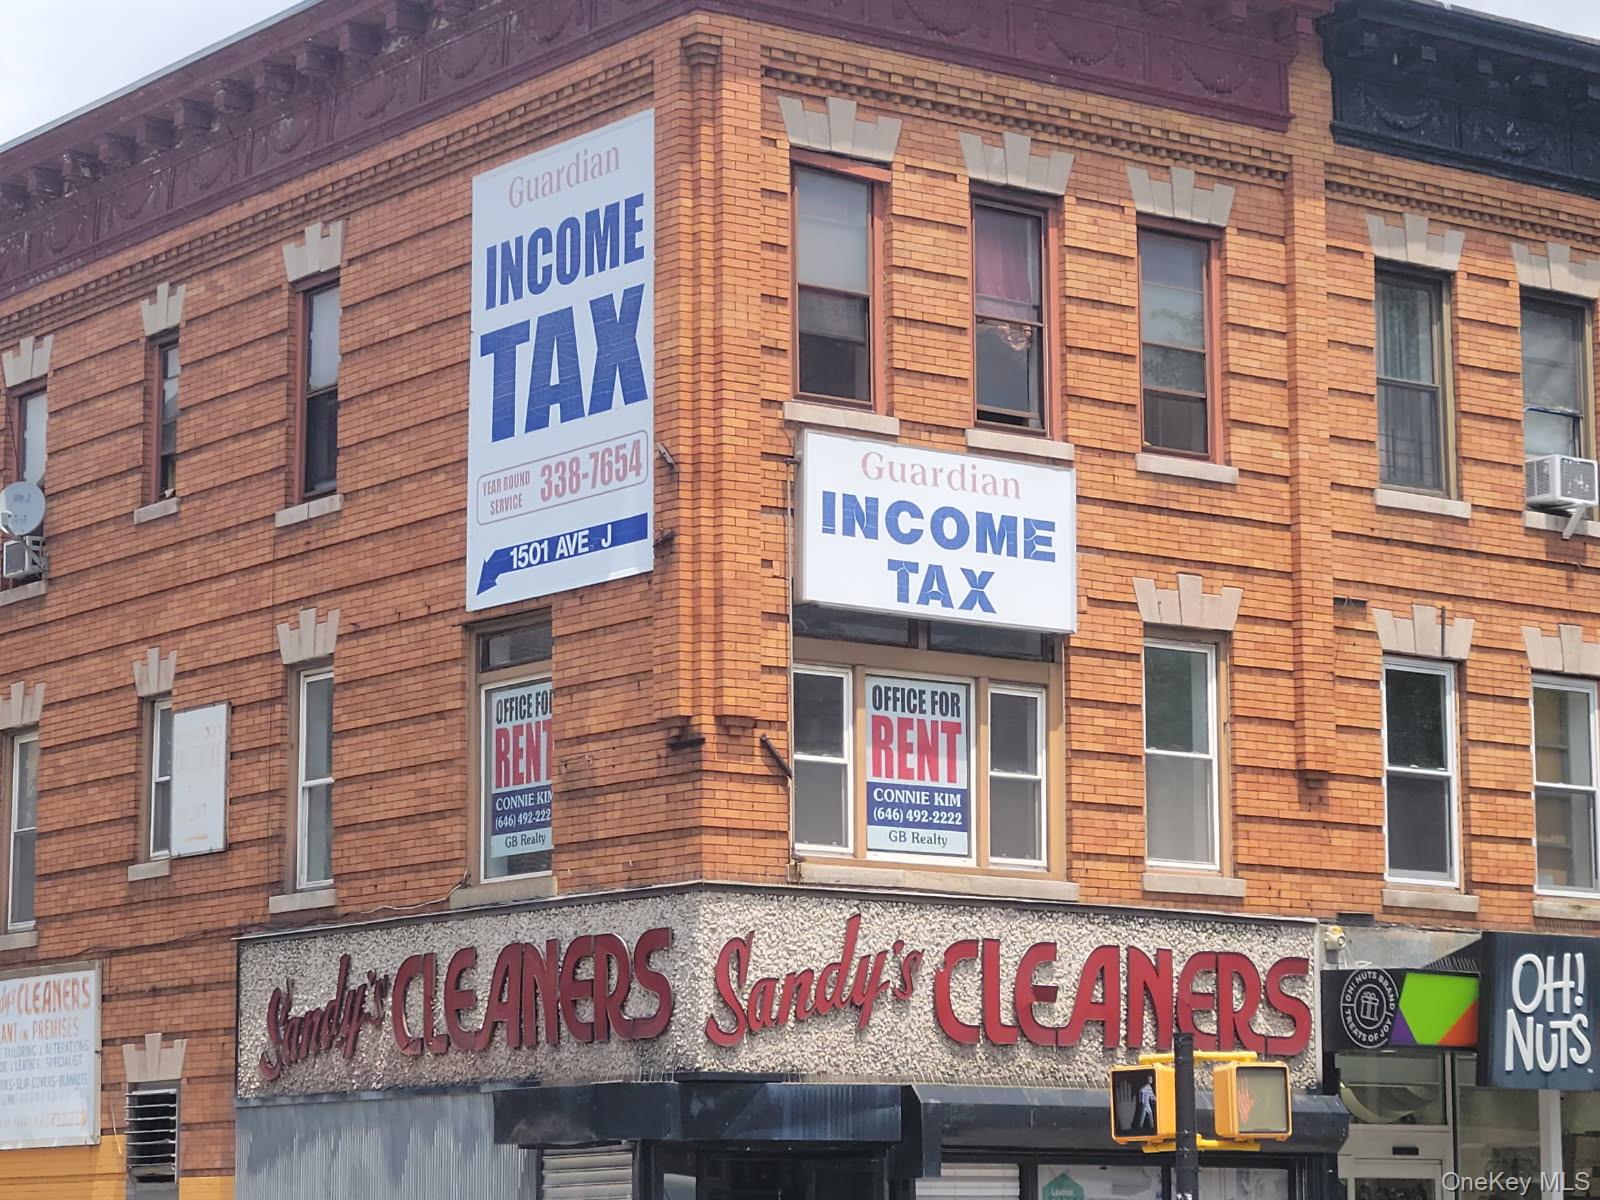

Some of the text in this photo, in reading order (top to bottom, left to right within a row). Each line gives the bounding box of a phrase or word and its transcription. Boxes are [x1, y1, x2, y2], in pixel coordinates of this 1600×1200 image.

[508, 146, 621, 208] Guardian
[485, 192, 645, 311] INCOME
[480, 283, 649, 443] TAX
[482, 470, 531, 497] YEAR ROUND
[540, 439, 642, 503] 338-7654
[860, 451, 1021, 499] Guardian
[490, 493, 523, 516] SERVICE
[510, 540, 549, 569] 1501
[601, 523, 612, 548] J
[821, 490, 1056, 563] INCOME
[887, 558, 997, 614] TAX
[496, 692, 533, 725] OFFICE
[871, 684, 961, 718] OFFICE FOR
[495, 719, 552, 789] RENT
[871, 714, 962, 784] RENT
[496, 792, 534, 812] CONNIE
[873, 788, 962, 808] CONNIE KIM
[873, 807, 963, 826] (646) 492-2222
[495, 808, 552, 831] (646) 492-222
[504, 832, 546, 848] GB Realty
[888, 830, 948, 848] GB Realty
[16, 975, 91, 1016] CLEANERS
[258, 926, 675, 1081] Sandy's CLEANERS
[703, 913, 1313, 1057] Sandy's CLEANERS
[1345, 970, 1396, 1010] OH! NUTS BRAND
[1511, 952, 1586, 1014] OH!
[32, 1015, 80, 1041] PREMISES
[1345, 1008, 1392, 1043] TREATS OF JOY
